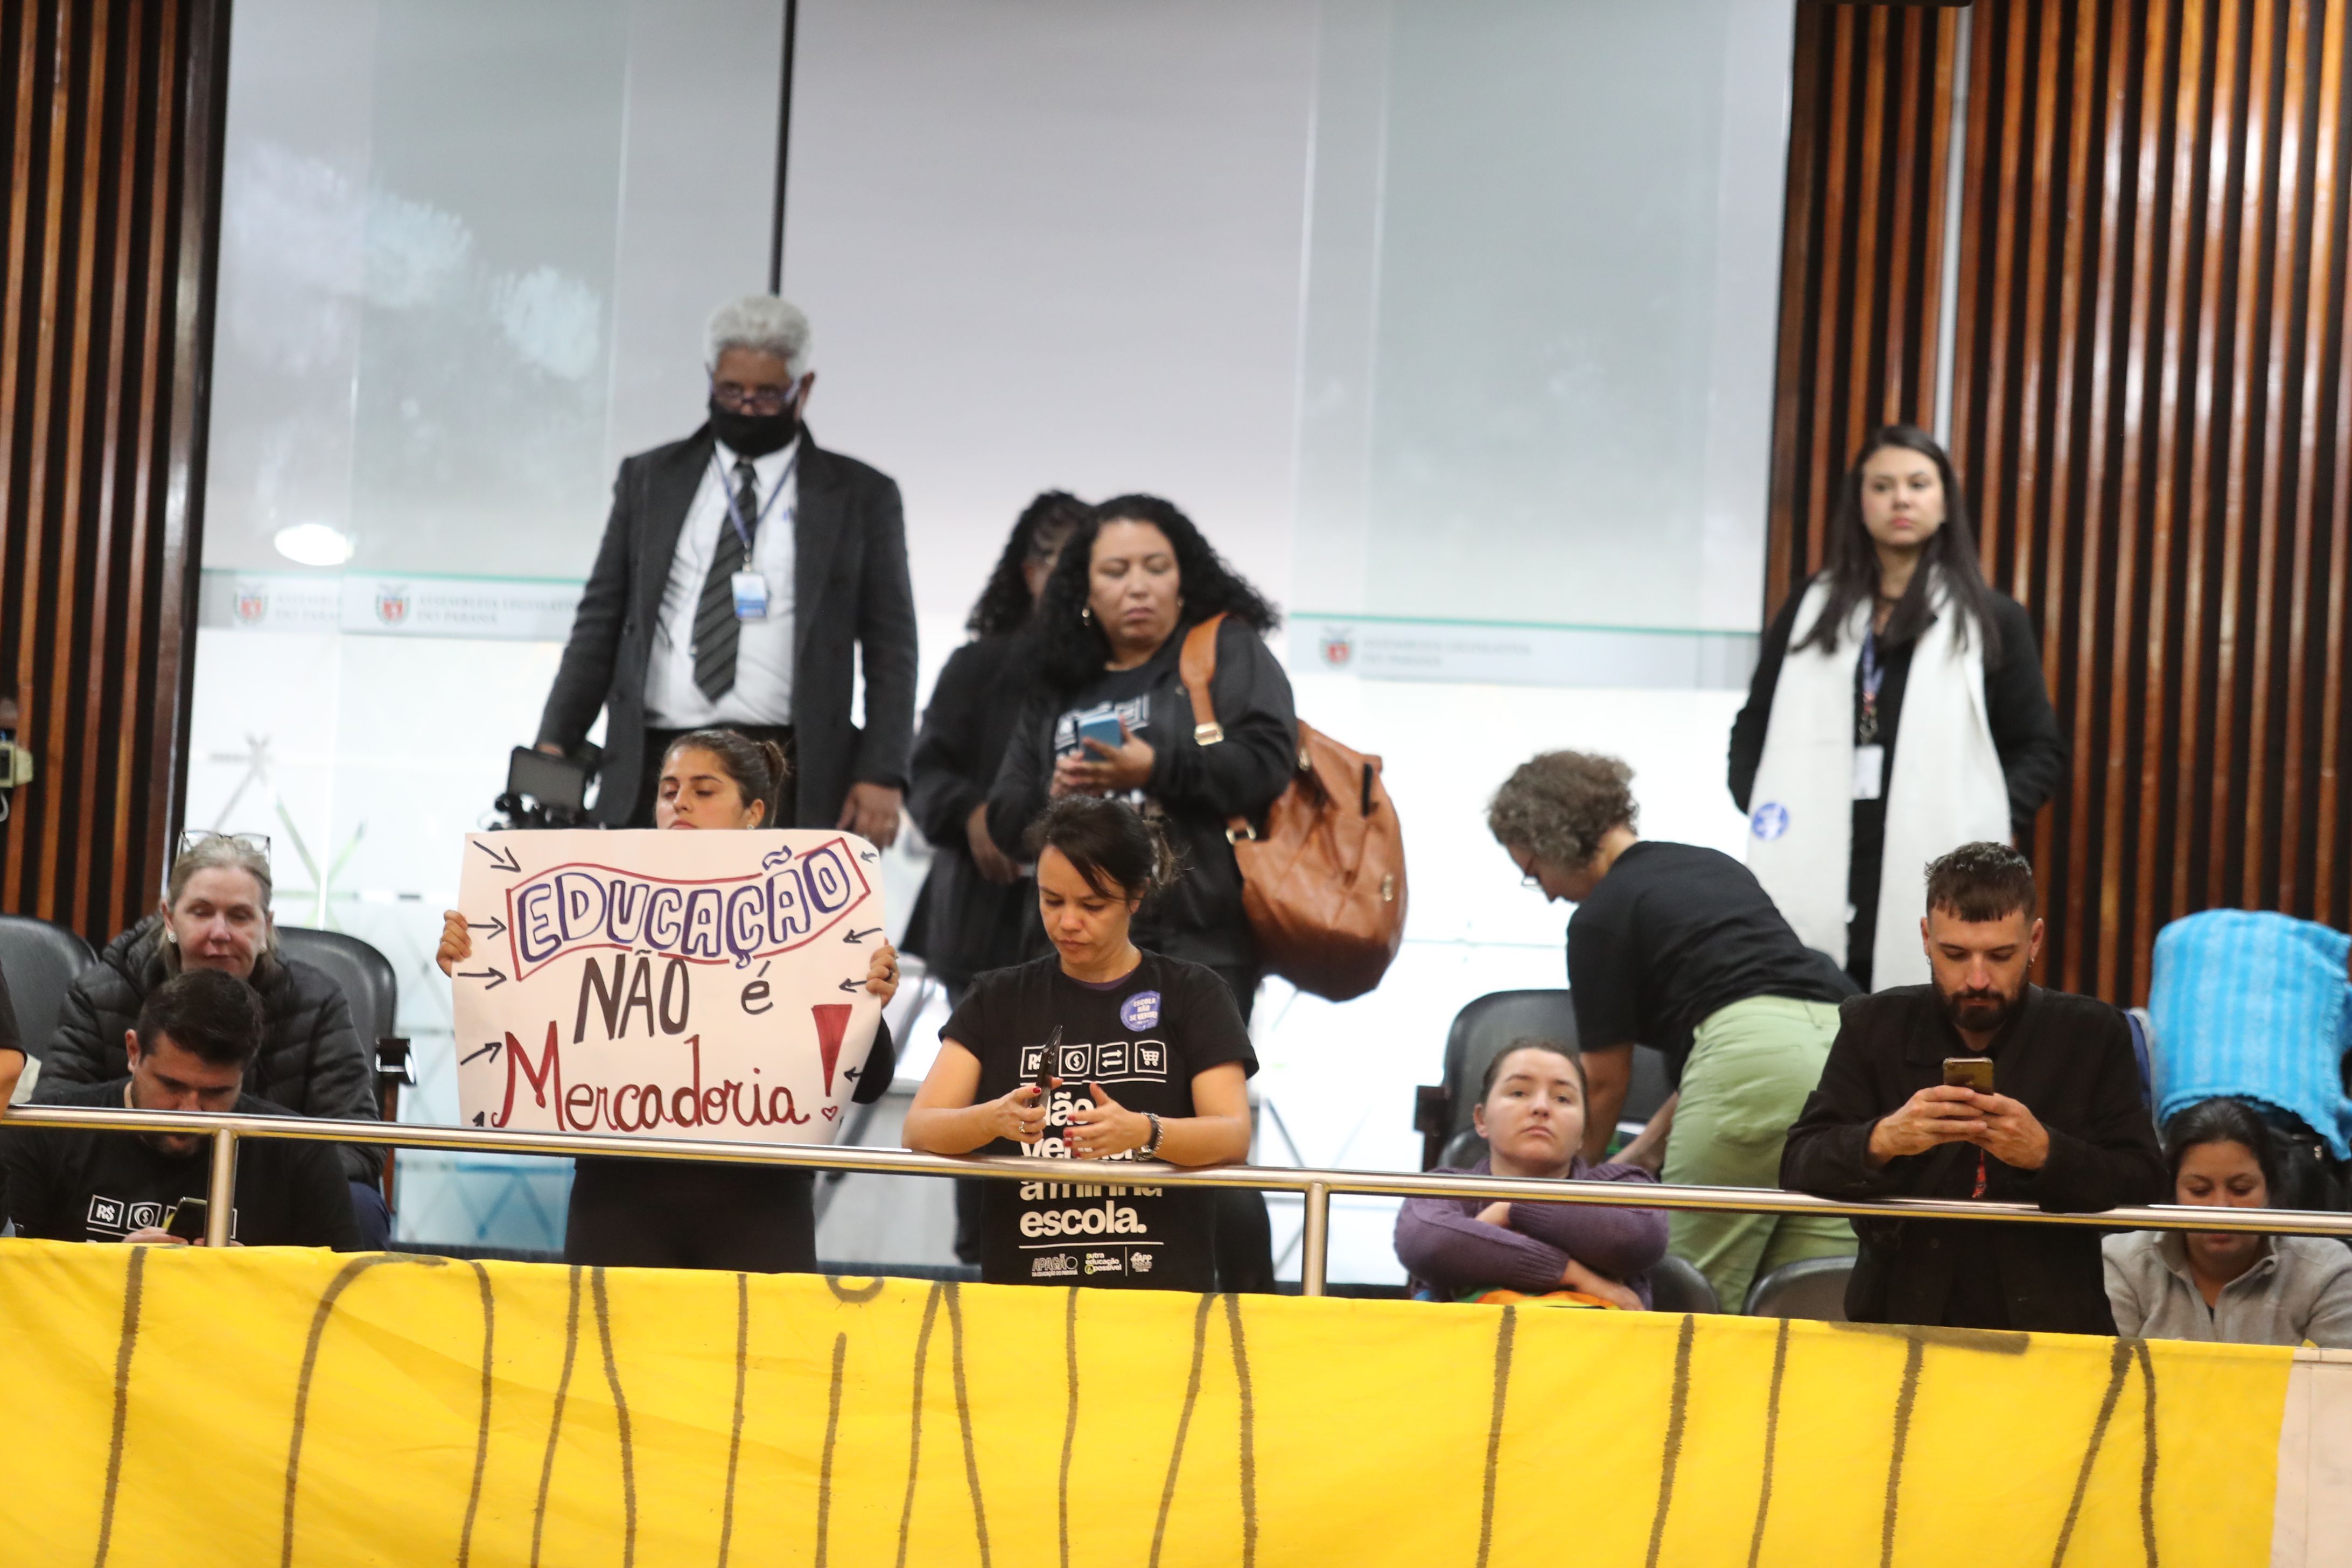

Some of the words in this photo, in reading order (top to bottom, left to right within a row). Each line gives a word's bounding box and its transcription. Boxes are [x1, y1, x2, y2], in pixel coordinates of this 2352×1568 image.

[517, 845, 851, 968] EDUCAÇÃO
[573, 950, 690, 1044] NÃO
[741, 960, 773, 1016] é
[1044, 1091, 1094, 1126] ão
[1020, 1200, 1147, 1238] escola.
